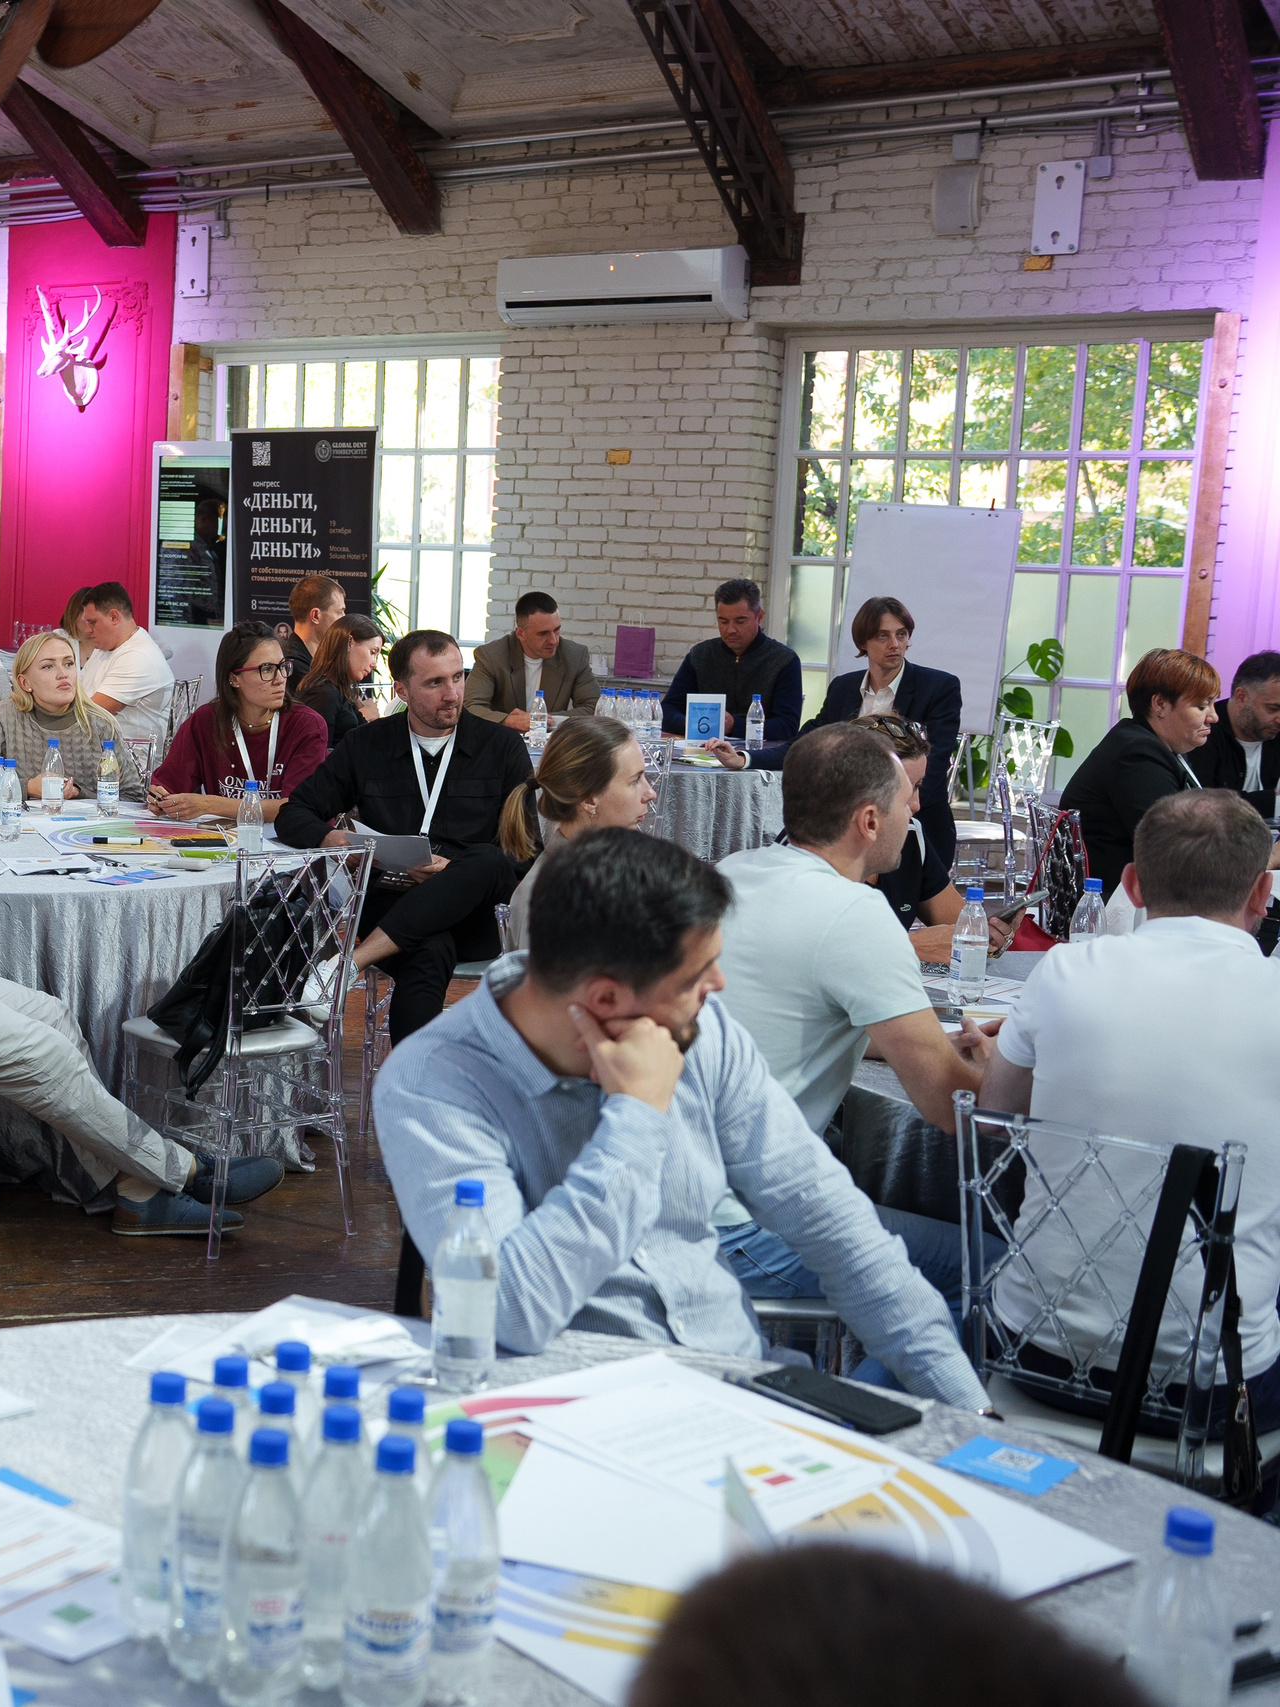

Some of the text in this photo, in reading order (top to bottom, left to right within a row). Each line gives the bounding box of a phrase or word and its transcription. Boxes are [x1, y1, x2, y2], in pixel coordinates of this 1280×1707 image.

[252, 481, 280, 489] конгресс
[243, 493, 318, 512] «ДЕНЬГИ,
[250, 517, 317, 536] ДЕНЬГИ,
[329, 527, 352, 535] октября
[250, 541, 322, 560] ДЕНЬГИ»
[258, 567, 304, 575] собственников
[318, 569, 367, 578] собственников
[251, 599, 257, 610] 8
[698, 716, 710, 734] 6
